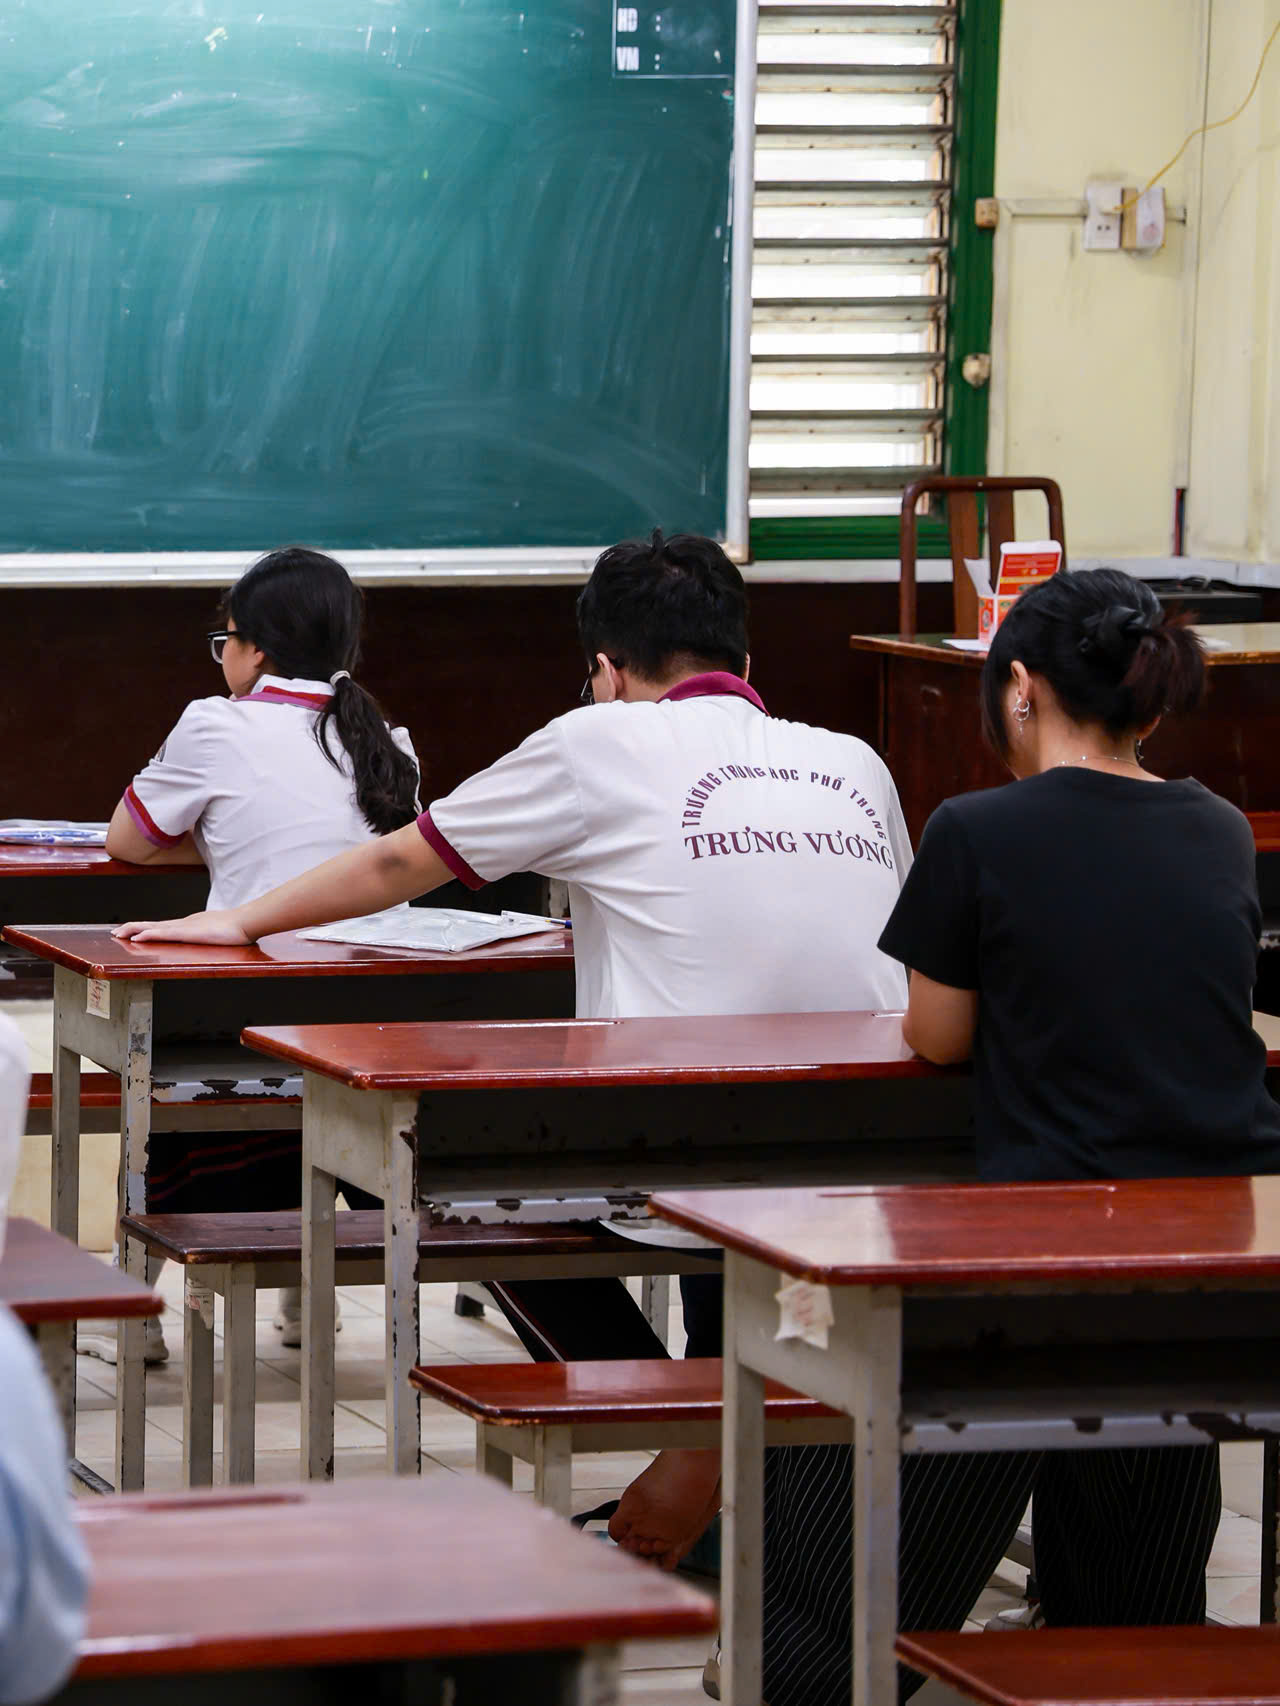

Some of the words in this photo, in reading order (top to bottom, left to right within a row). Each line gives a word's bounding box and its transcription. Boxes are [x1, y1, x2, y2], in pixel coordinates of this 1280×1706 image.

[682, 771, 722, 828] TRƯỜNG
[719, 764, 766, 781] TRUNG
[768, 766, 799, 782] HỌC
[849, 788, 887, 840] THÔNG
[684, 826, 797, 860] TRƯNG
[802, 829, 894, 871] VƯƠNG
